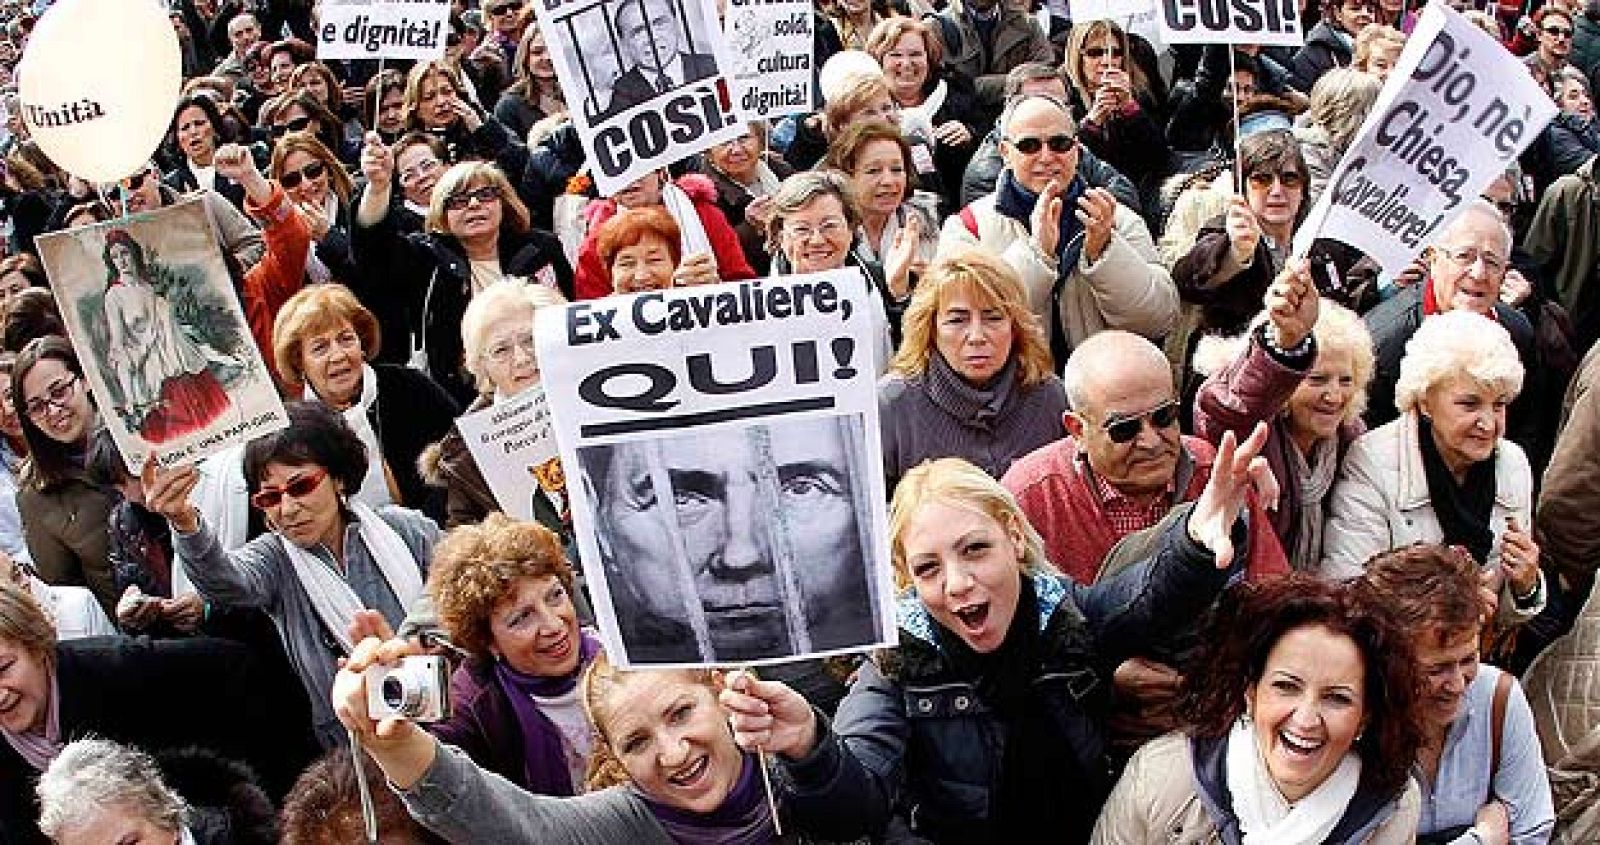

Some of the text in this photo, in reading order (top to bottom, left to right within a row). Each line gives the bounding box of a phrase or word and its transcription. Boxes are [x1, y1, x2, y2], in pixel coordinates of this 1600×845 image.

[322, 14, 441, 52] e dignità!
[773, 12, 812, 38] soldi,
[757, 50, 809, 74] cultura
[1411, 30, 1476, 123] Dio,
[742, 82, 807, 115] dignità!
[1376, 101, 1471, 211] Chiesa,
[1331, 156, 1444, 249] Cavaliere!
[567, 280, 853, 346] Ex Cavaliere,
[578, 337, 858, 412] QUI!
